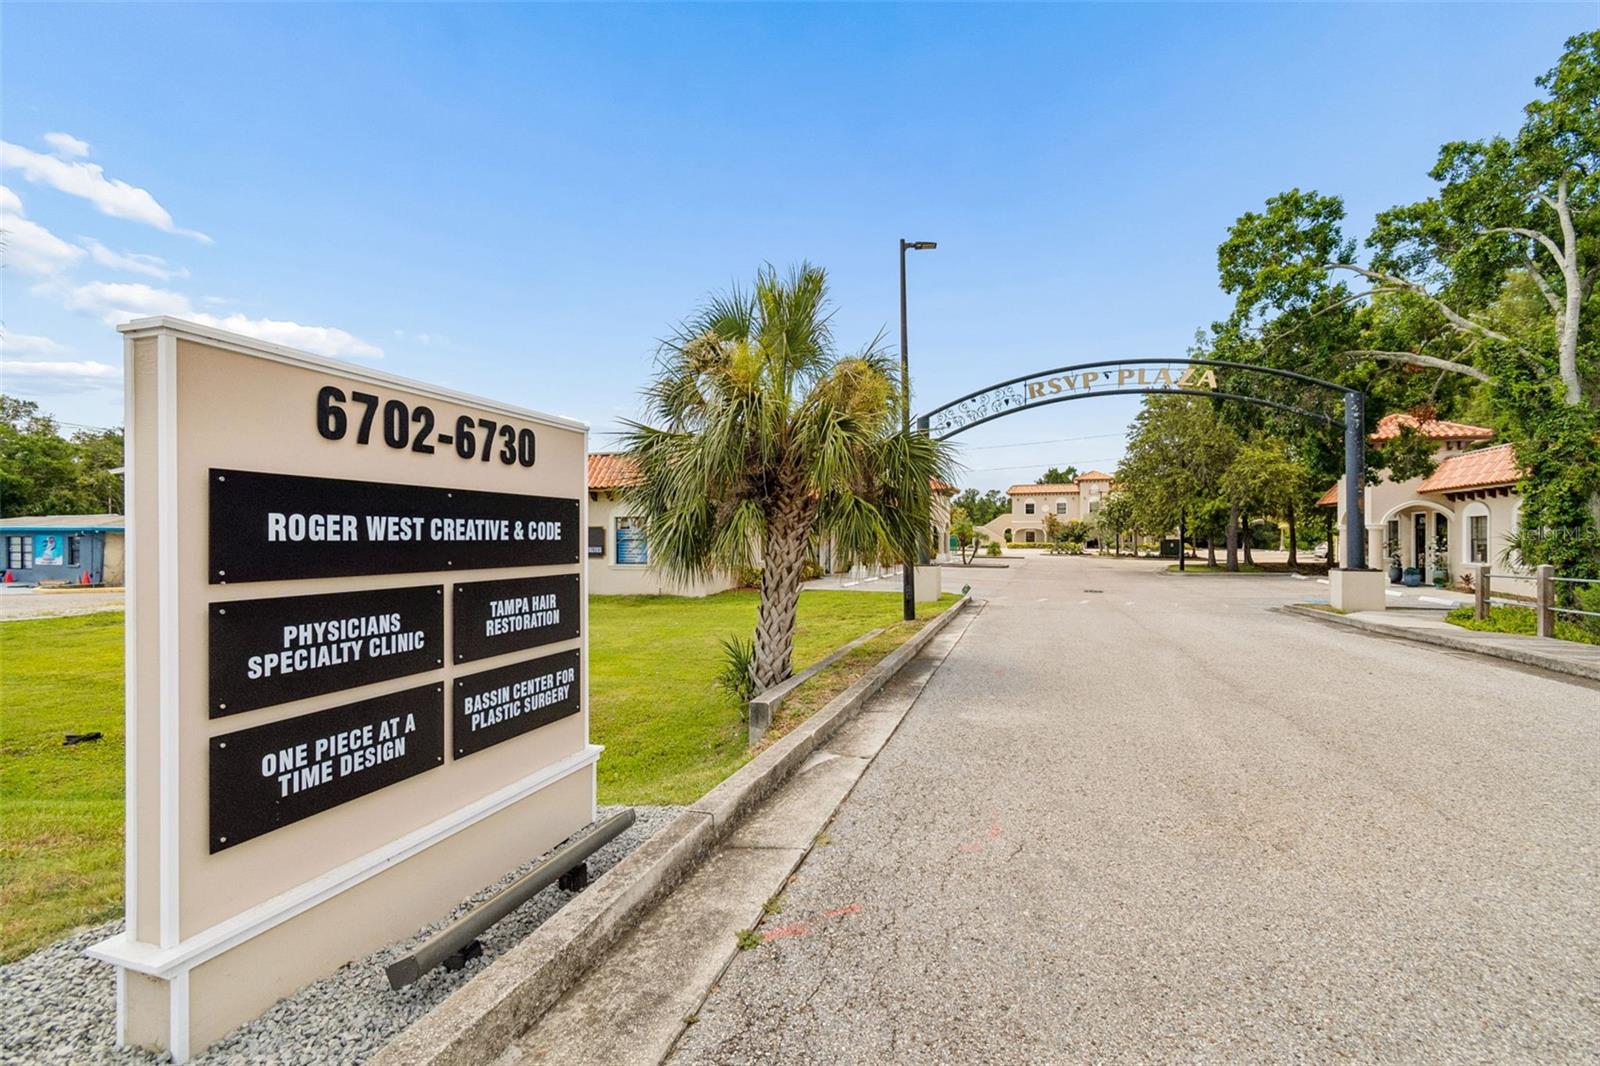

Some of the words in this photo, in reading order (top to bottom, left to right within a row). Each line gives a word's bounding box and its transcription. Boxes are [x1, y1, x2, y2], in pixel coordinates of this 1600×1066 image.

[1118, 367, 1217, 388] PLAZA
[316, 385, 536, 468] 6702-6730
[268, 512, 358, 542] ROGER
[366, 515, 425, 541] WEST
[430, 518, 509, 541] CREATIVE
[514, 520, 525, 541] &
[528, 521, 562, 541] CODE
[485, 609, 560, 637] RESTORATION
[489, 598, 530, 618] TAMPA
[531, 593, 557, 612] HAIR
[247, 639, 364, 680] SPECIALTY
[369, 630, 425, 658] CLINIC
[283, 613, 401, 649] PHYSICIANS
[464, 685, 510, 715] BASSIN
[512, 673, 554, 700] CENTER
[556, 667, 575, 687] FOR
[471, 700, 521, 732] PLASTIC
[524, 683, 570, 713] SURGERY
[261, 743, 308, 777] ONE
[315, 724, 373, 762] PIECE
[378, 716, 400, 742] AT
[404, 713, 416, 734] A
[277, 759, 333, 798] TIME
[340, 736, 406, 777] DESIGN
